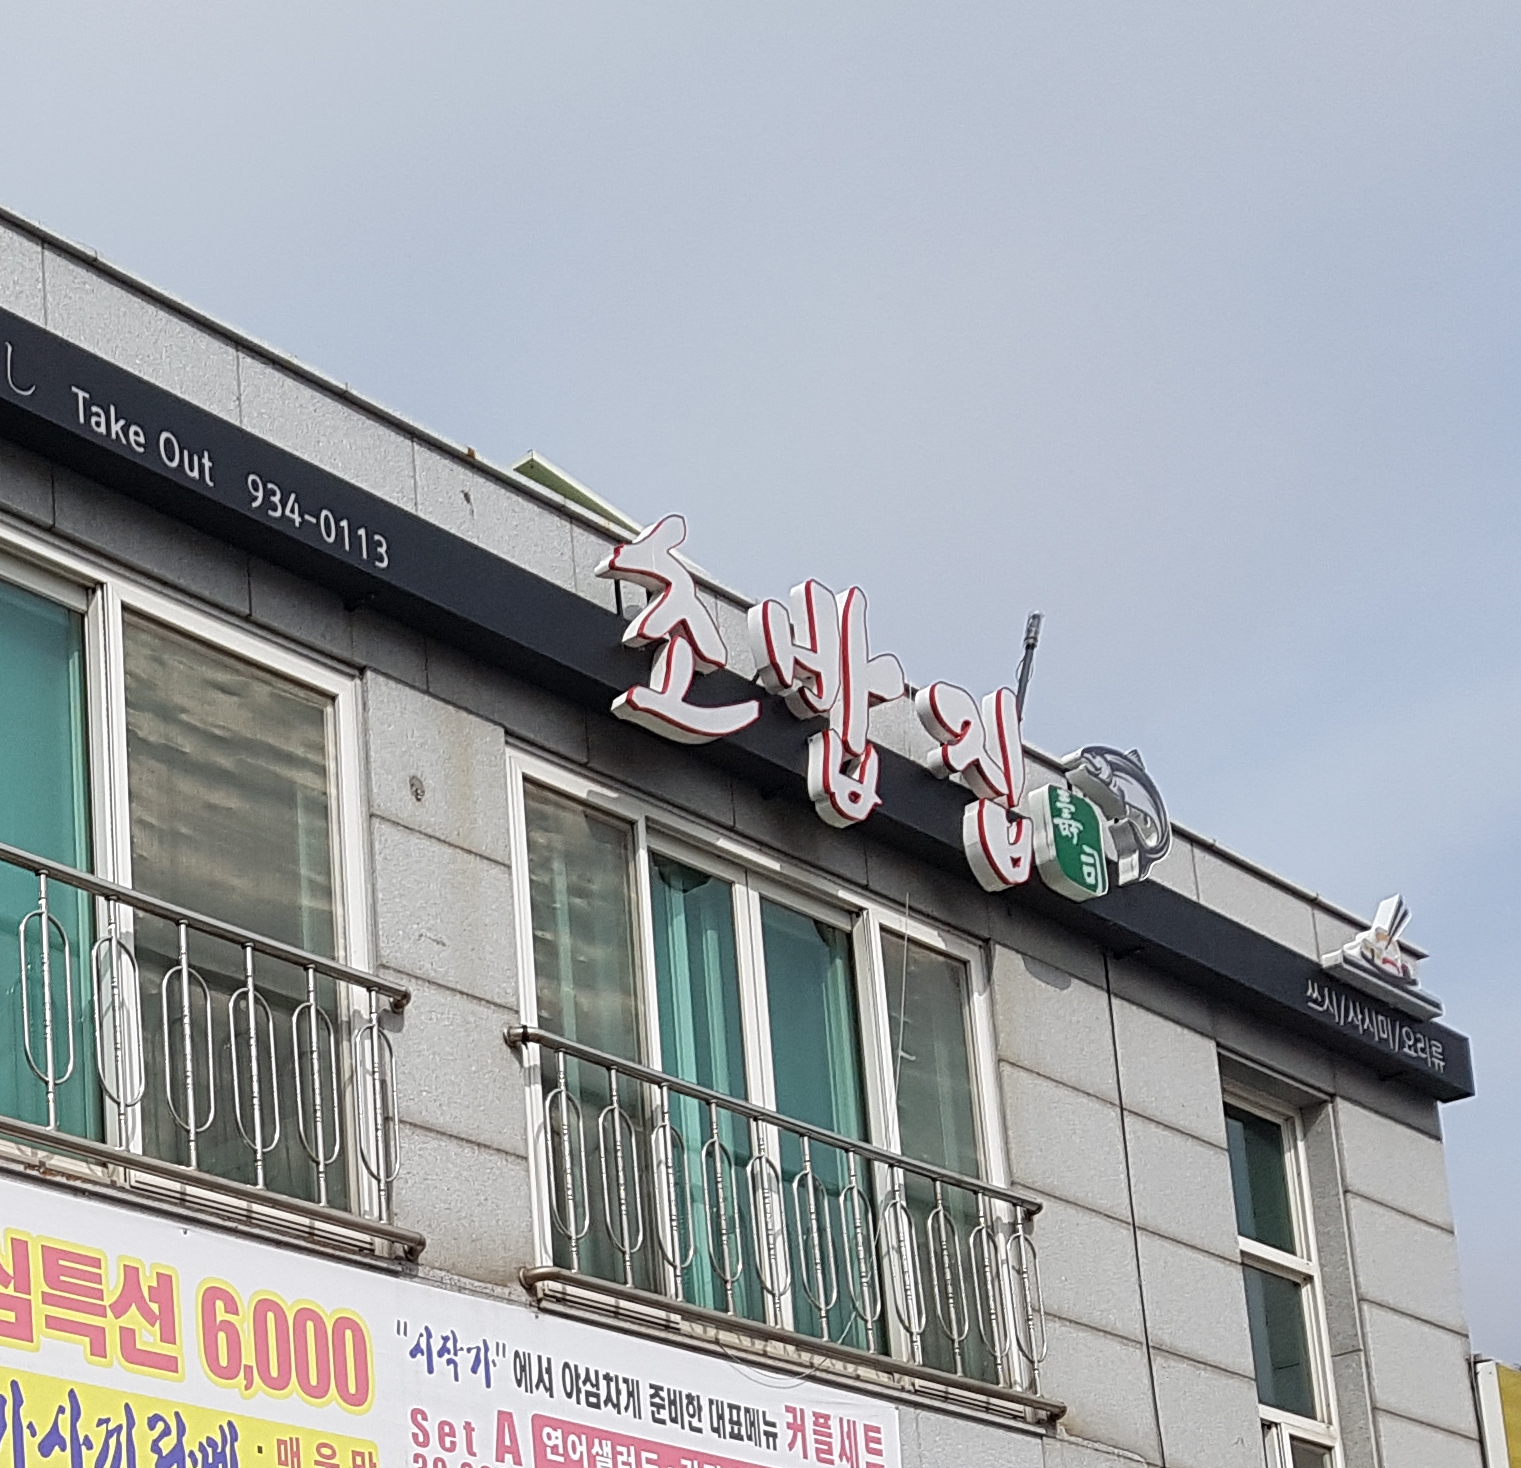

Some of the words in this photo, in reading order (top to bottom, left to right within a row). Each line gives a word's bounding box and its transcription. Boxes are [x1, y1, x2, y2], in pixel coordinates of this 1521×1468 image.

[71, 385, 147, 454] Take
[158, 431, 215, 488] Out
[246, 473, 390, 570] 934-0113
[595, 513, 1034, 890] 초밥집
[200, 1285, 371, 1408] 6,000
[561, 1361, 643, 1420] 야심차게
[648, 1382, 704, 1435] 준비한
[708, 1397, 779, 1451] 대표메뉴
[410, 1407, 477, 1457] Set
[494, 1409, 523, 1467] A
